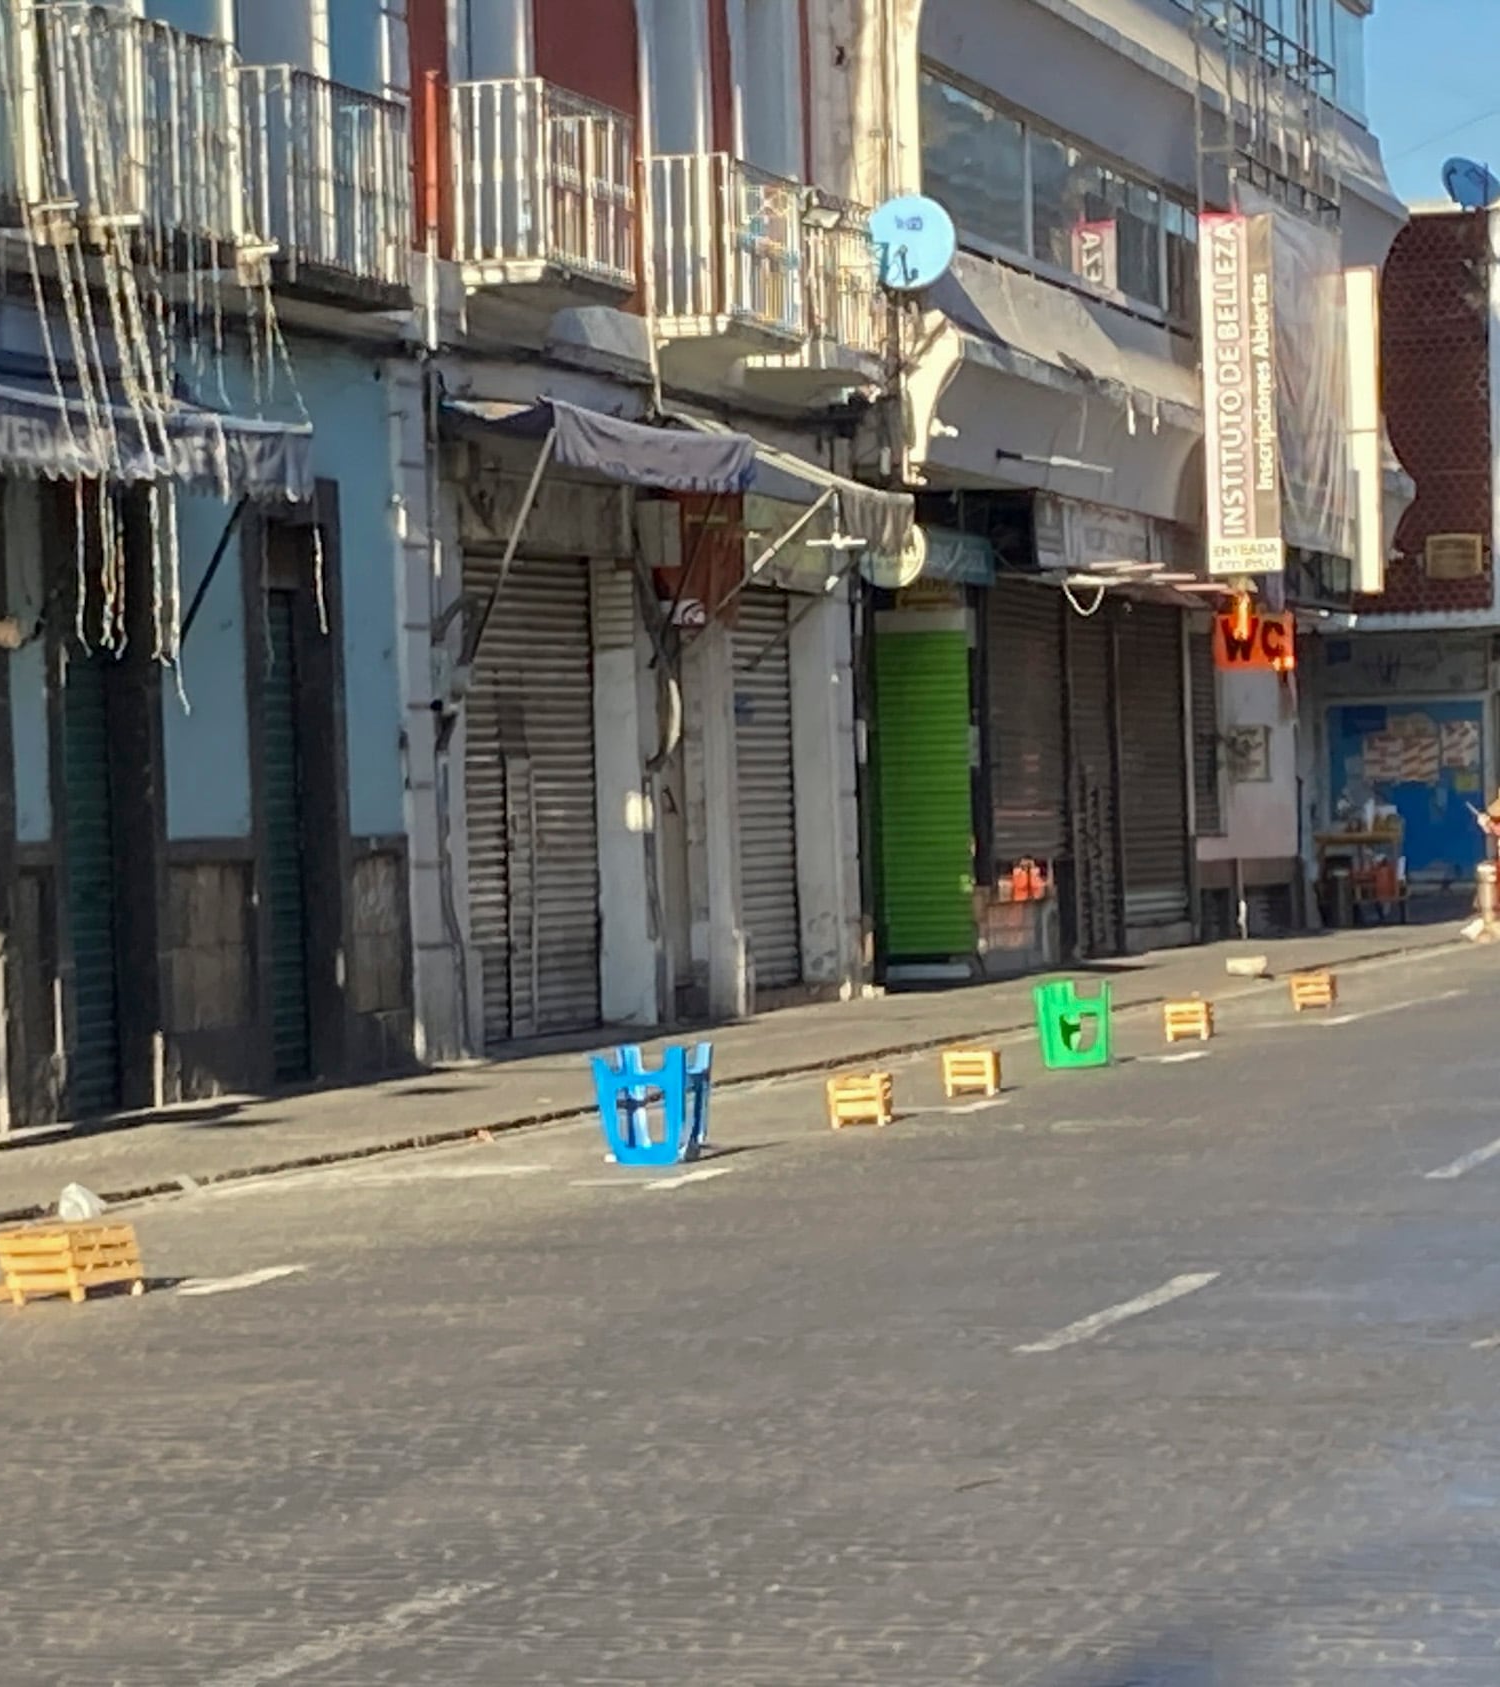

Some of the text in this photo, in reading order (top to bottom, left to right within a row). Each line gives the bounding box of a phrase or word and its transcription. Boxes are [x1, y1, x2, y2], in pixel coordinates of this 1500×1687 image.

[1213, 221, 1247, 535] INSTITUTO DE BELLEZA
[1220, 616, 1286, 662] WC
